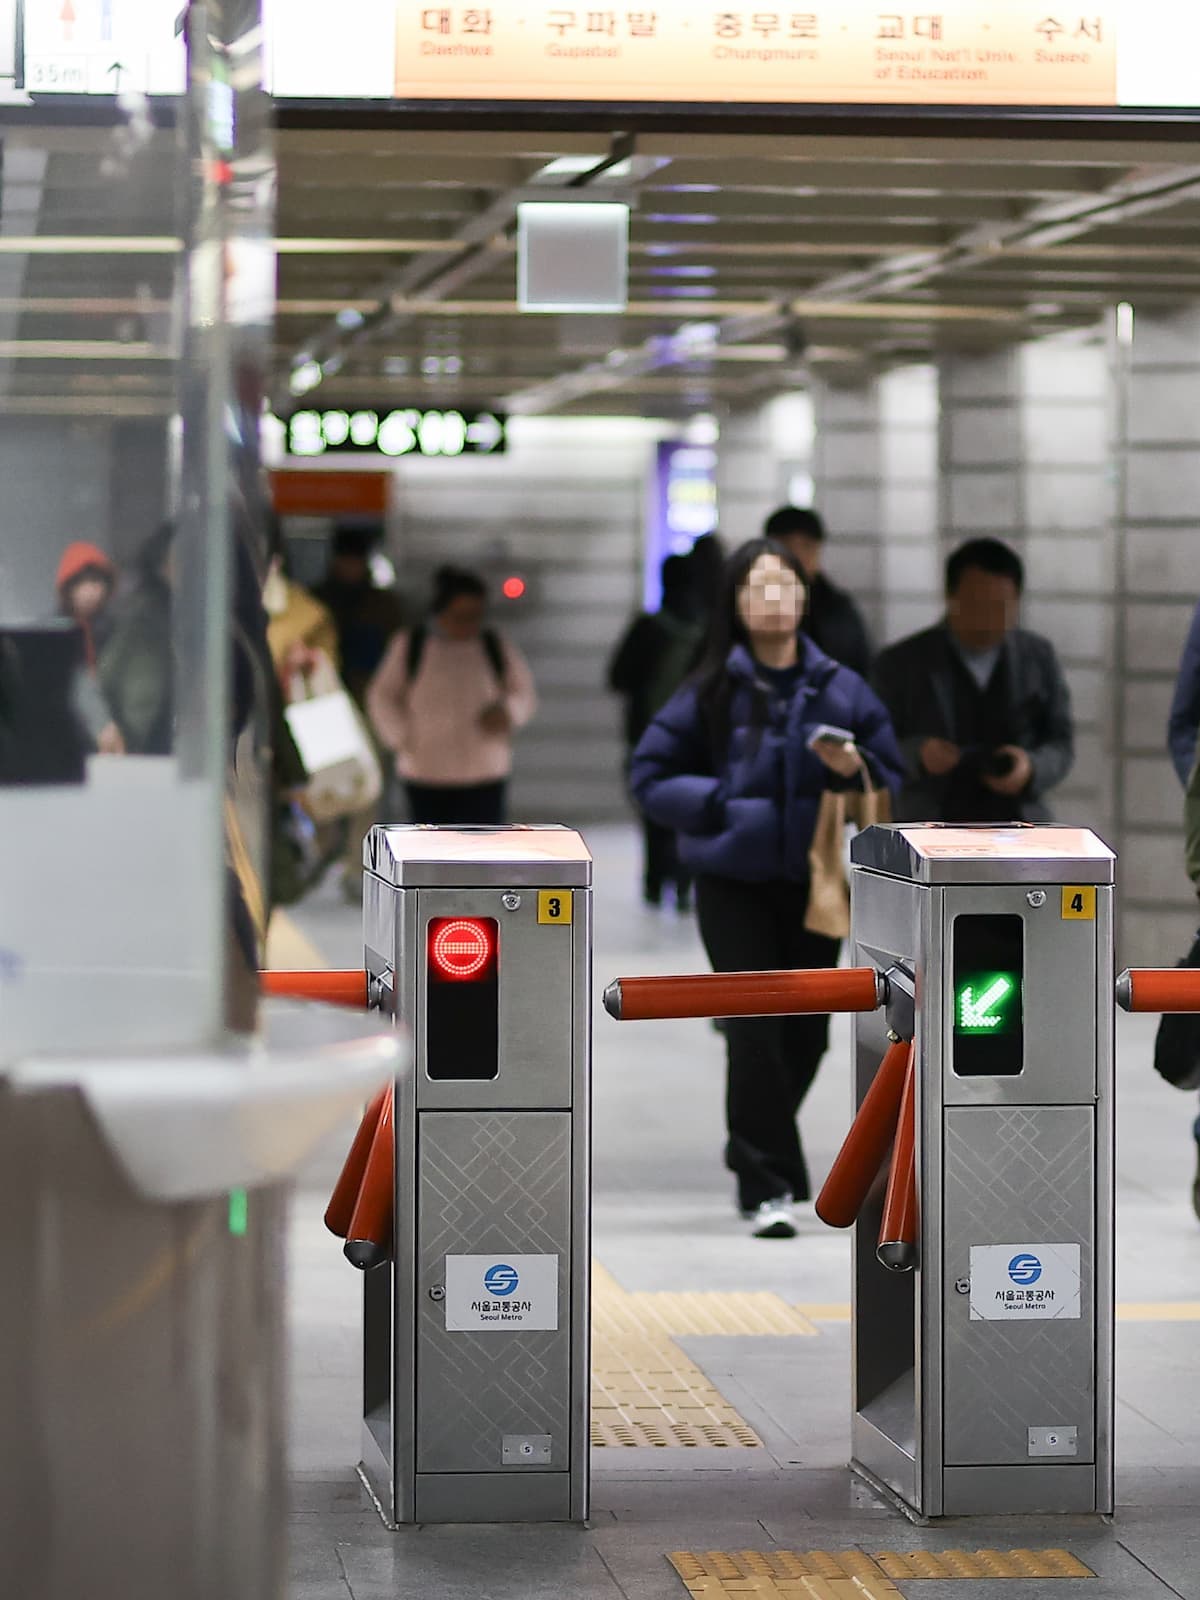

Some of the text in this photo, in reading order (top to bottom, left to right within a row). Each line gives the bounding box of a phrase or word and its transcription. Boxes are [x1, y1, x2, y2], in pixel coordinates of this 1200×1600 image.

[421, 8, 493, 35] 대화
[547, 10, 656, 38] 구파발
[714, 12, 820, 40] 충무로
[874, 14, 943, 41] 교대
[1034, 16, 1103, 43] 수서
[548, 898, 560, 917] 3
[1071, 893, 1083, 912] 4
[471, 1301, 532, 1312] 서울교통공사
[995, 1290, 1055, 1302] 서울교통공사
[480, 1313, 523, 1321] Seoul Metro
